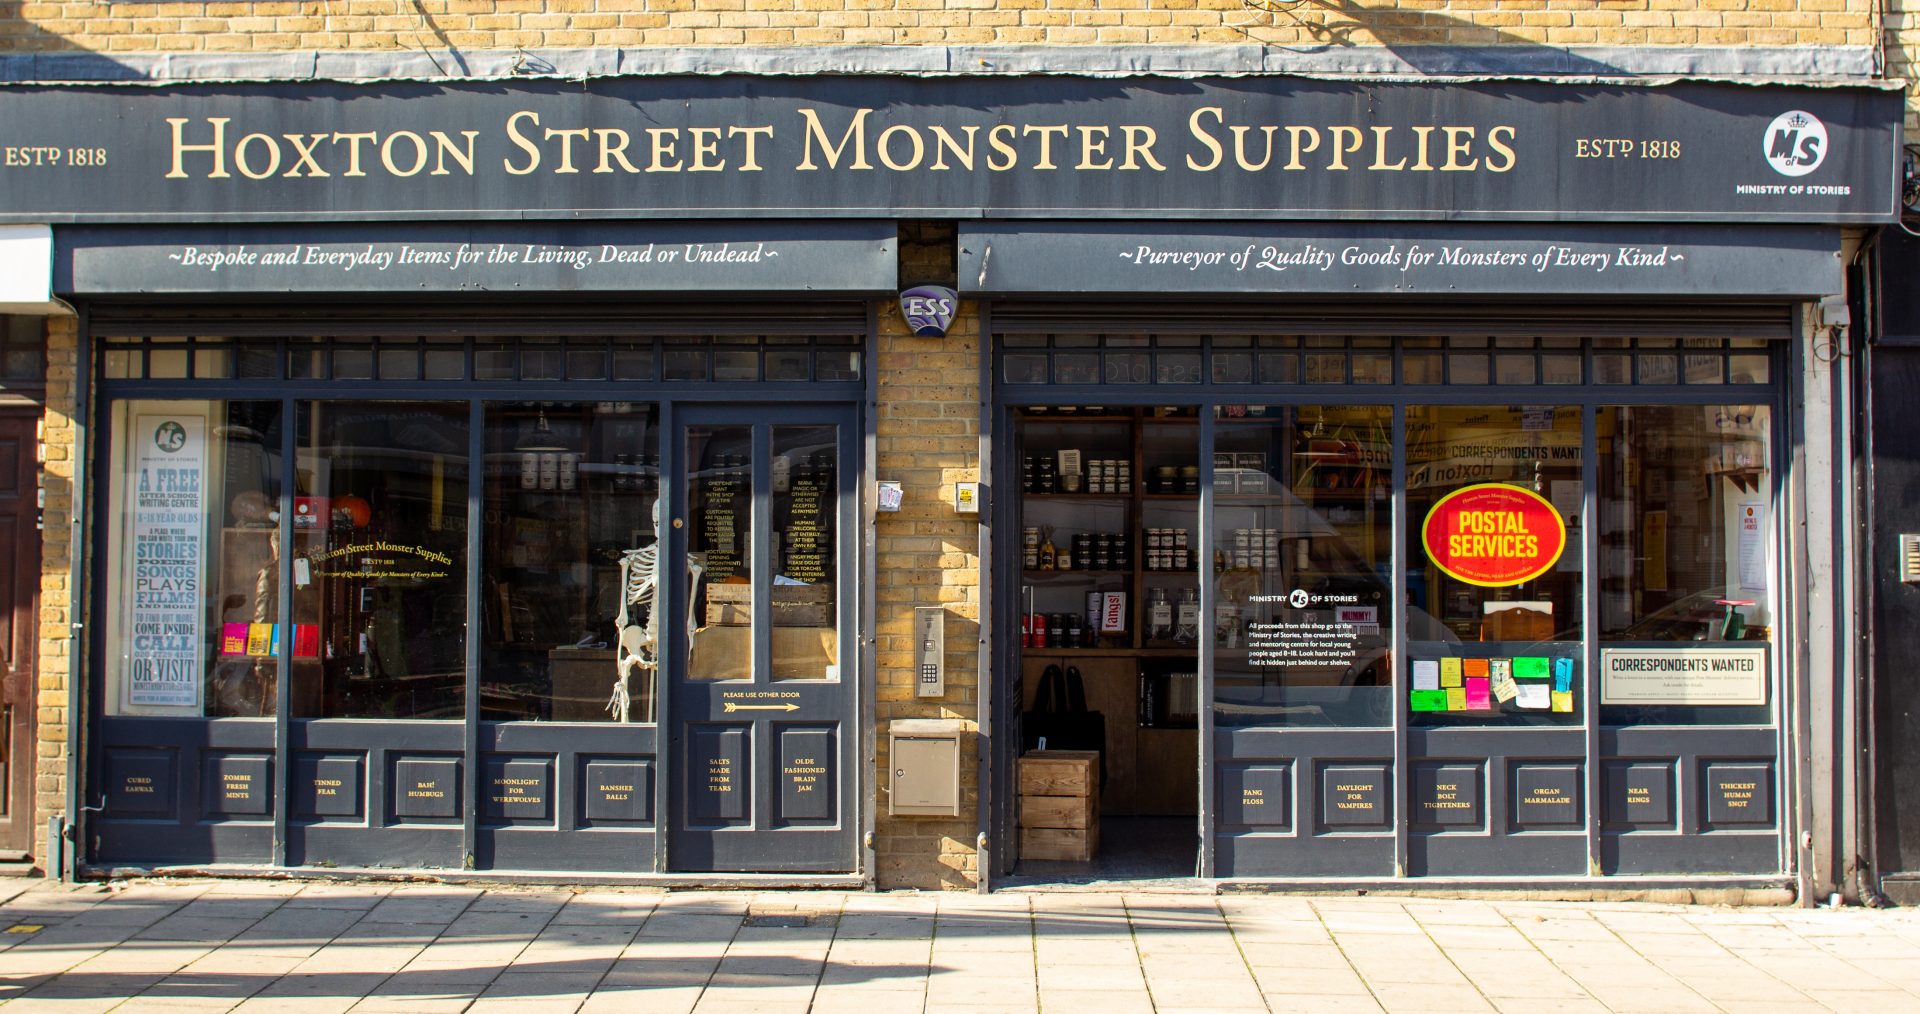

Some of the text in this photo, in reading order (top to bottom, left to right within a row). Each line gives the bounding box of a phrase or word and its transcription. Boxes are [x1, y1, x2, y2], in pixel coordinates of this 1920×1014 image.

[1641, 141, 1680, 158] 1818
[68, 148, 106, 166] 1818
[1737, 185, 1850, 194] MINISTRY OF STORIES
[261, 245, 300, 265] and
[303, 246, 393, 271] Everyday
[397, 246, 451, 265] Items
[450, 244, 484, 270] for
[488, 244, 518, 264] the
[522, 244, 592, 271] Living,
[598, 243, 653, 264] Dead
[657, 250, 679, 264] or
[1230, 244, 1256, 271] of
[1256, 244, 1335, 271] Quality
[1341, 244, 1400, 265] Goods
[1400, 246, 1434, 272] for
[1437, 247, 1528, 266] Monsters
[1532, 245, 1557, 272] of
[1554, 246, 1610, 272] Every
[910, 298, 951, 316] ESS
[1451, 446, 1582, 459] CORRESPONDENTS WANT
[139, 468, 199, 492] A FREE
[140, 499, 198, 508] WRITING CENTRE
[1459, 511, 1528, 533] POSTAL
[137, 543, 197, 559] STORIES
[1449, 535, 1538, 557] SERVICES
[347, 544, 374, 554] Street
[376, 541, 414, 553] Monster
[415, 545, 452, 565] Supplies
[136, 566, 196, 578] SONGS
[137, 579, 196, 591] PLAYS
[136, 591, 195, 604] FILMS
[1249, 595, 1287, 603] MINISTRY
[1311, 595, 1357, 603] OF STORIES
[135, 623, 195, 636] COME INSIDE
[1249, 632, 1272, 640] Ministry
[1337, 632, 1356, 640] writing
[135, 635, 194, 651] CALL
[1334, 641, 1351, 649] young
[1249, 650, 1268, 658] people
[1269, 650, 1282, 658] aged
[134, 659, 194, 682] OR VISIT
[1612, 658, 1754, 671] CORRESPONDENTS WANTED
